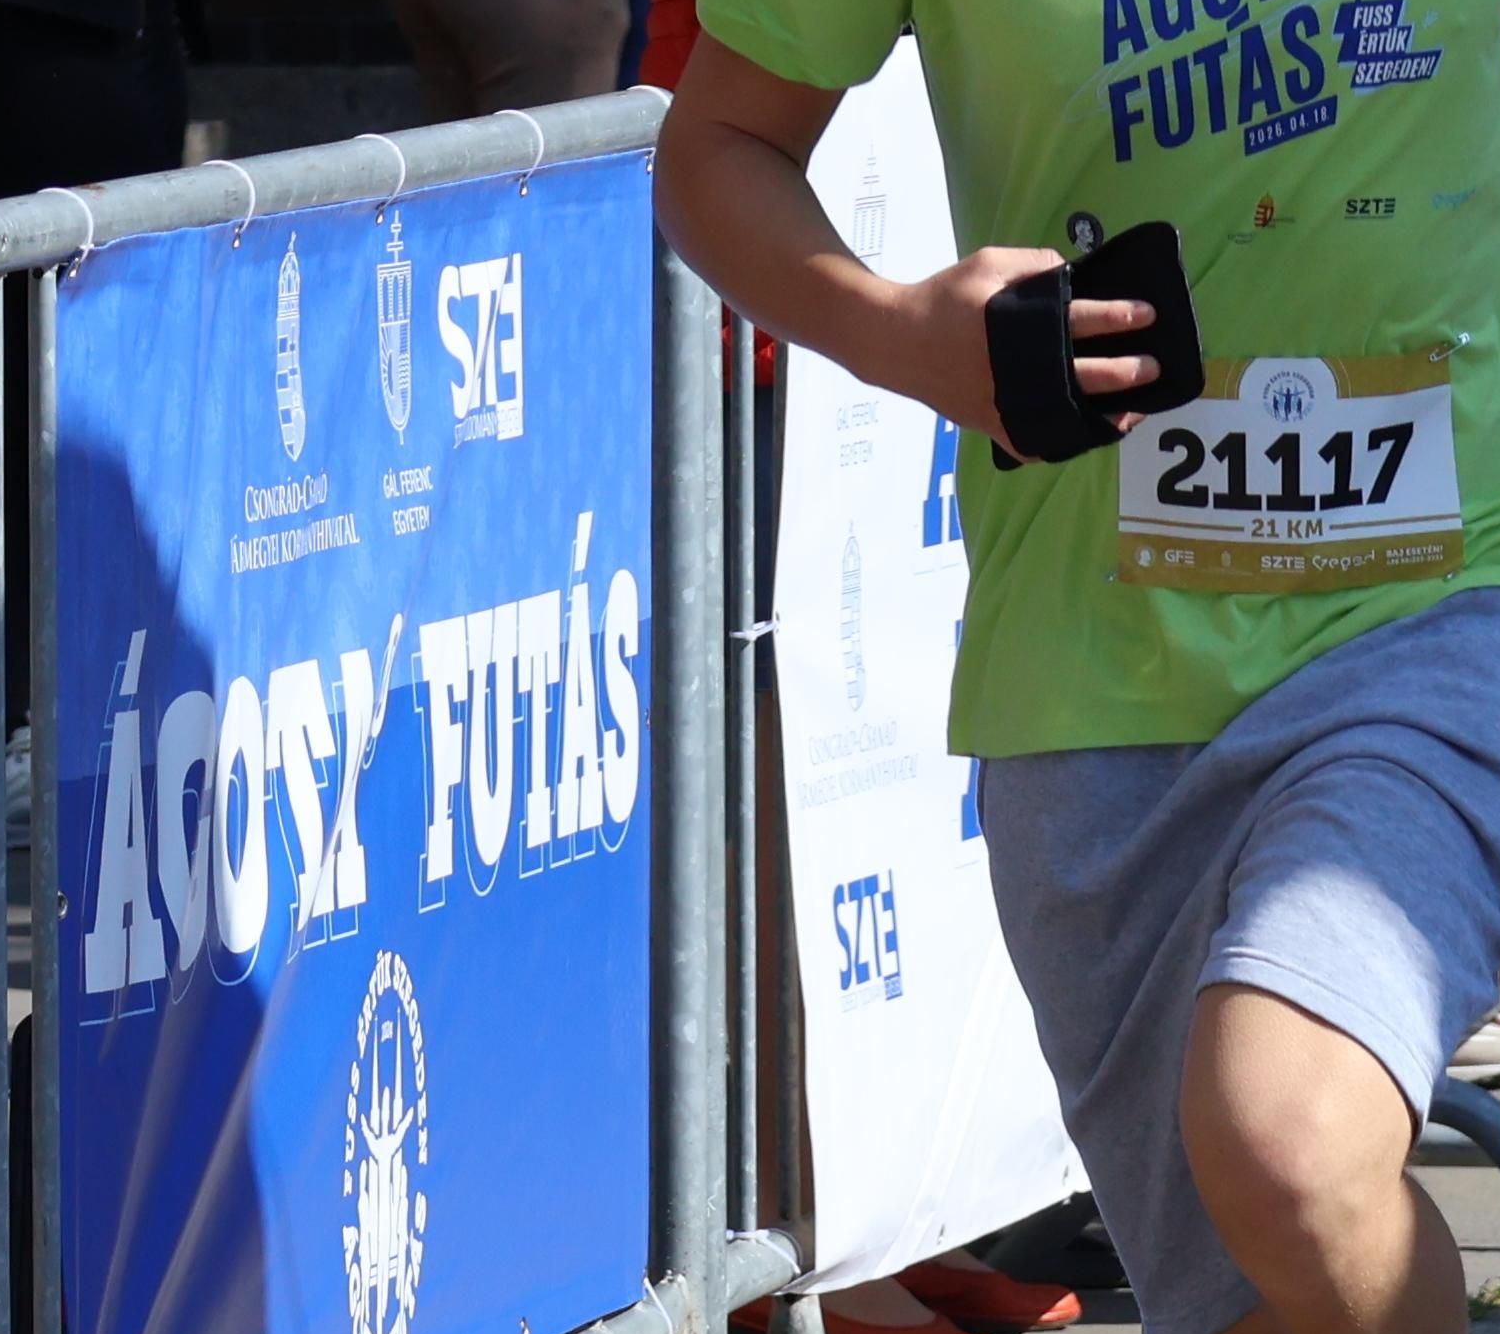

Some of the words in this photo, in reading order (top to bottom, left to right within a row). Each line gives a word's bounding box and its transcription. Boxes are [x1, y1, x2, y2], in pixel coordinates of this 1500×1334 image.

[1353, 4, 1394, 29] FUSS
[1357, 27, 1408, 55] ÉRTÜK
[1108, 4, 1325, 163] FUTÁS
[1355, 55, 1436, 85] SZEGEDEN!
[1345, 198, 1397, 214] SZTE
[1156, 422, 1414, 511] 21117
[383, 468, 400, 499] GÁL
[400, 466, 434, 497] FERENC
[1251, 519, 1279, 539] 21
[1288, 518, 1324, 539] KM
[1164, 549, 1195, 565] GFE
[1261, 555, 1305, 570] SZTE
[423, 512, 639, 883] FUTÁS
[832, 868, 901, 991] SZTE
